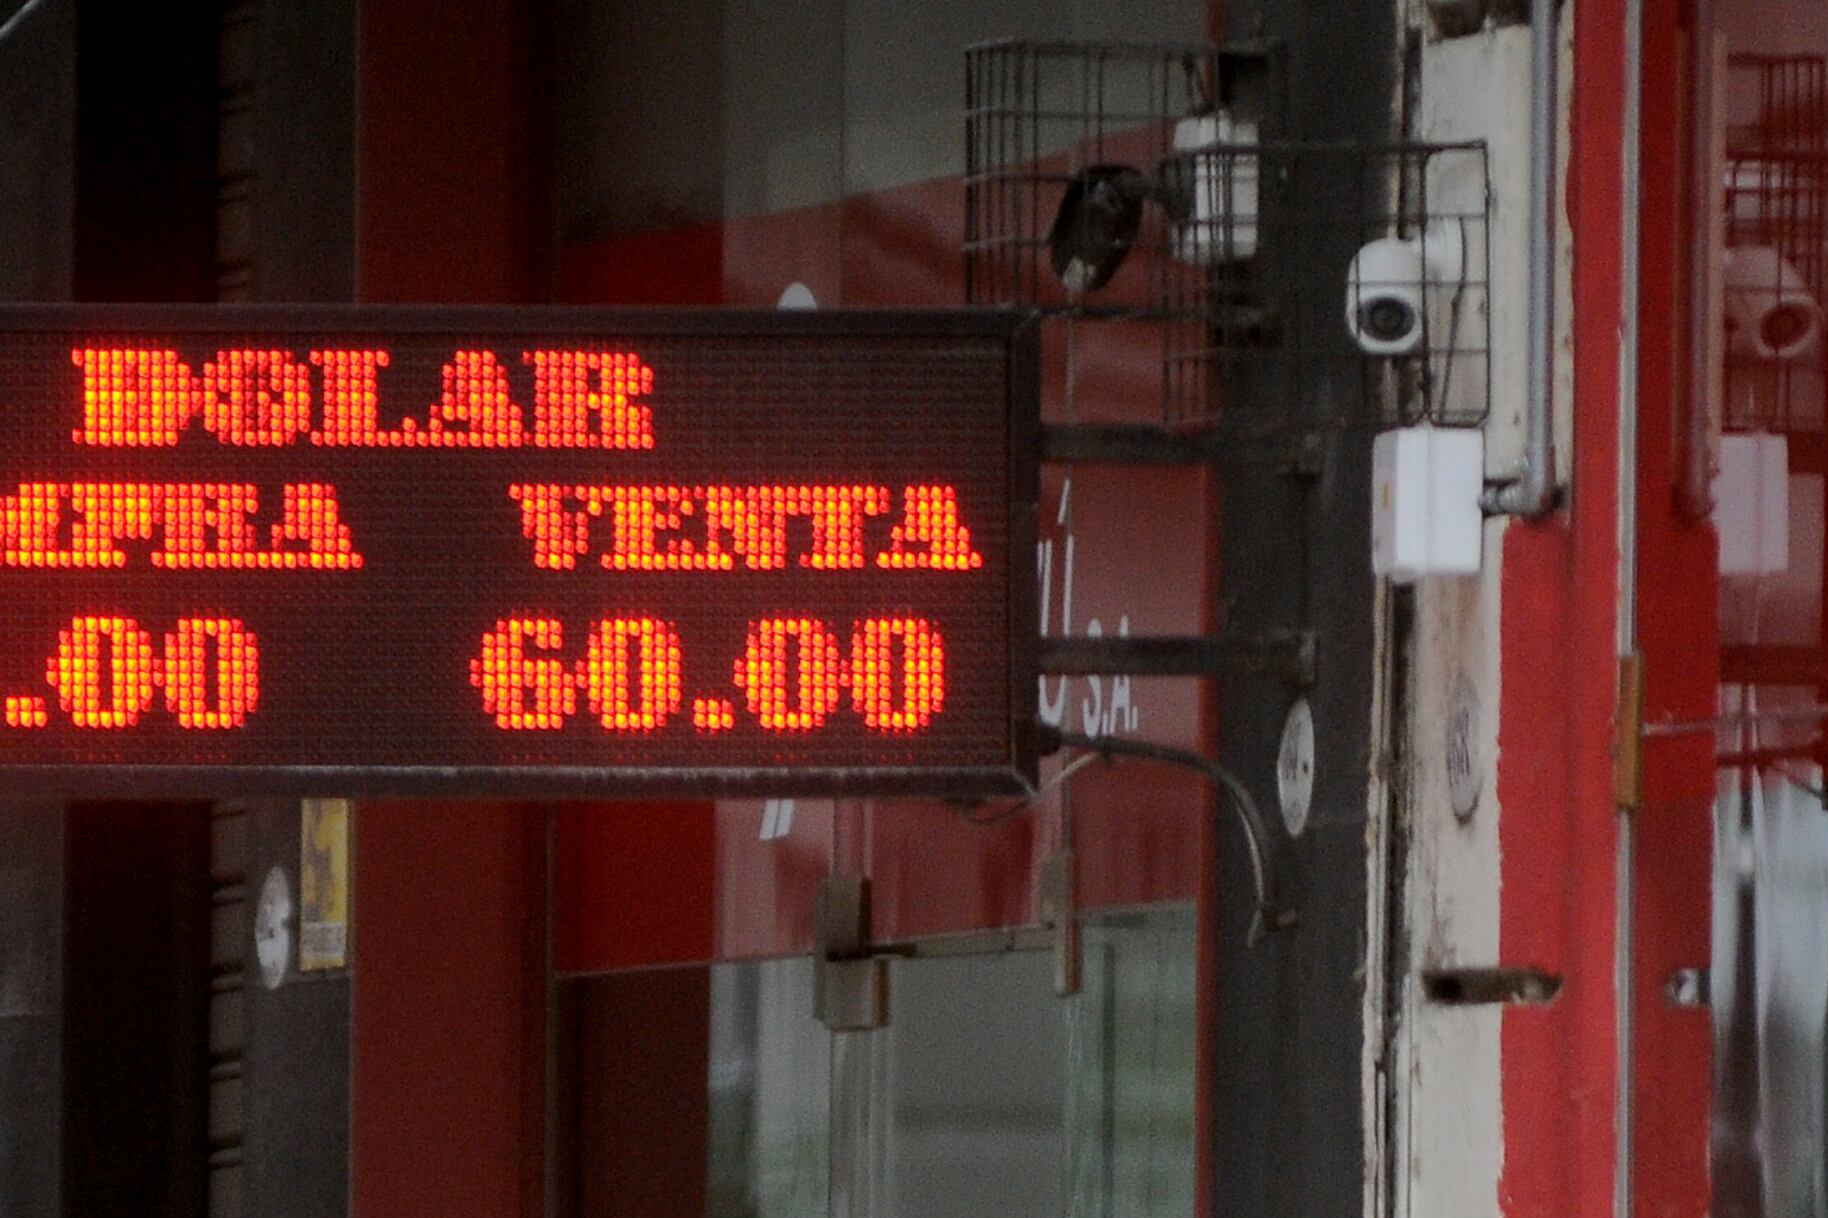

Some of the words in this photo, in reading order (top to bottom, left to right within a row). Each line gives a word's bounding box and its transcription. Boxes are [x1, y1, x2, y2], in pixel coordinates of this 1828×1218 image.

[72, 347, 655, 449] DOLAR
[508, 482, 982, 571] VENTA
[470, 614, 945, 732] 60.00
